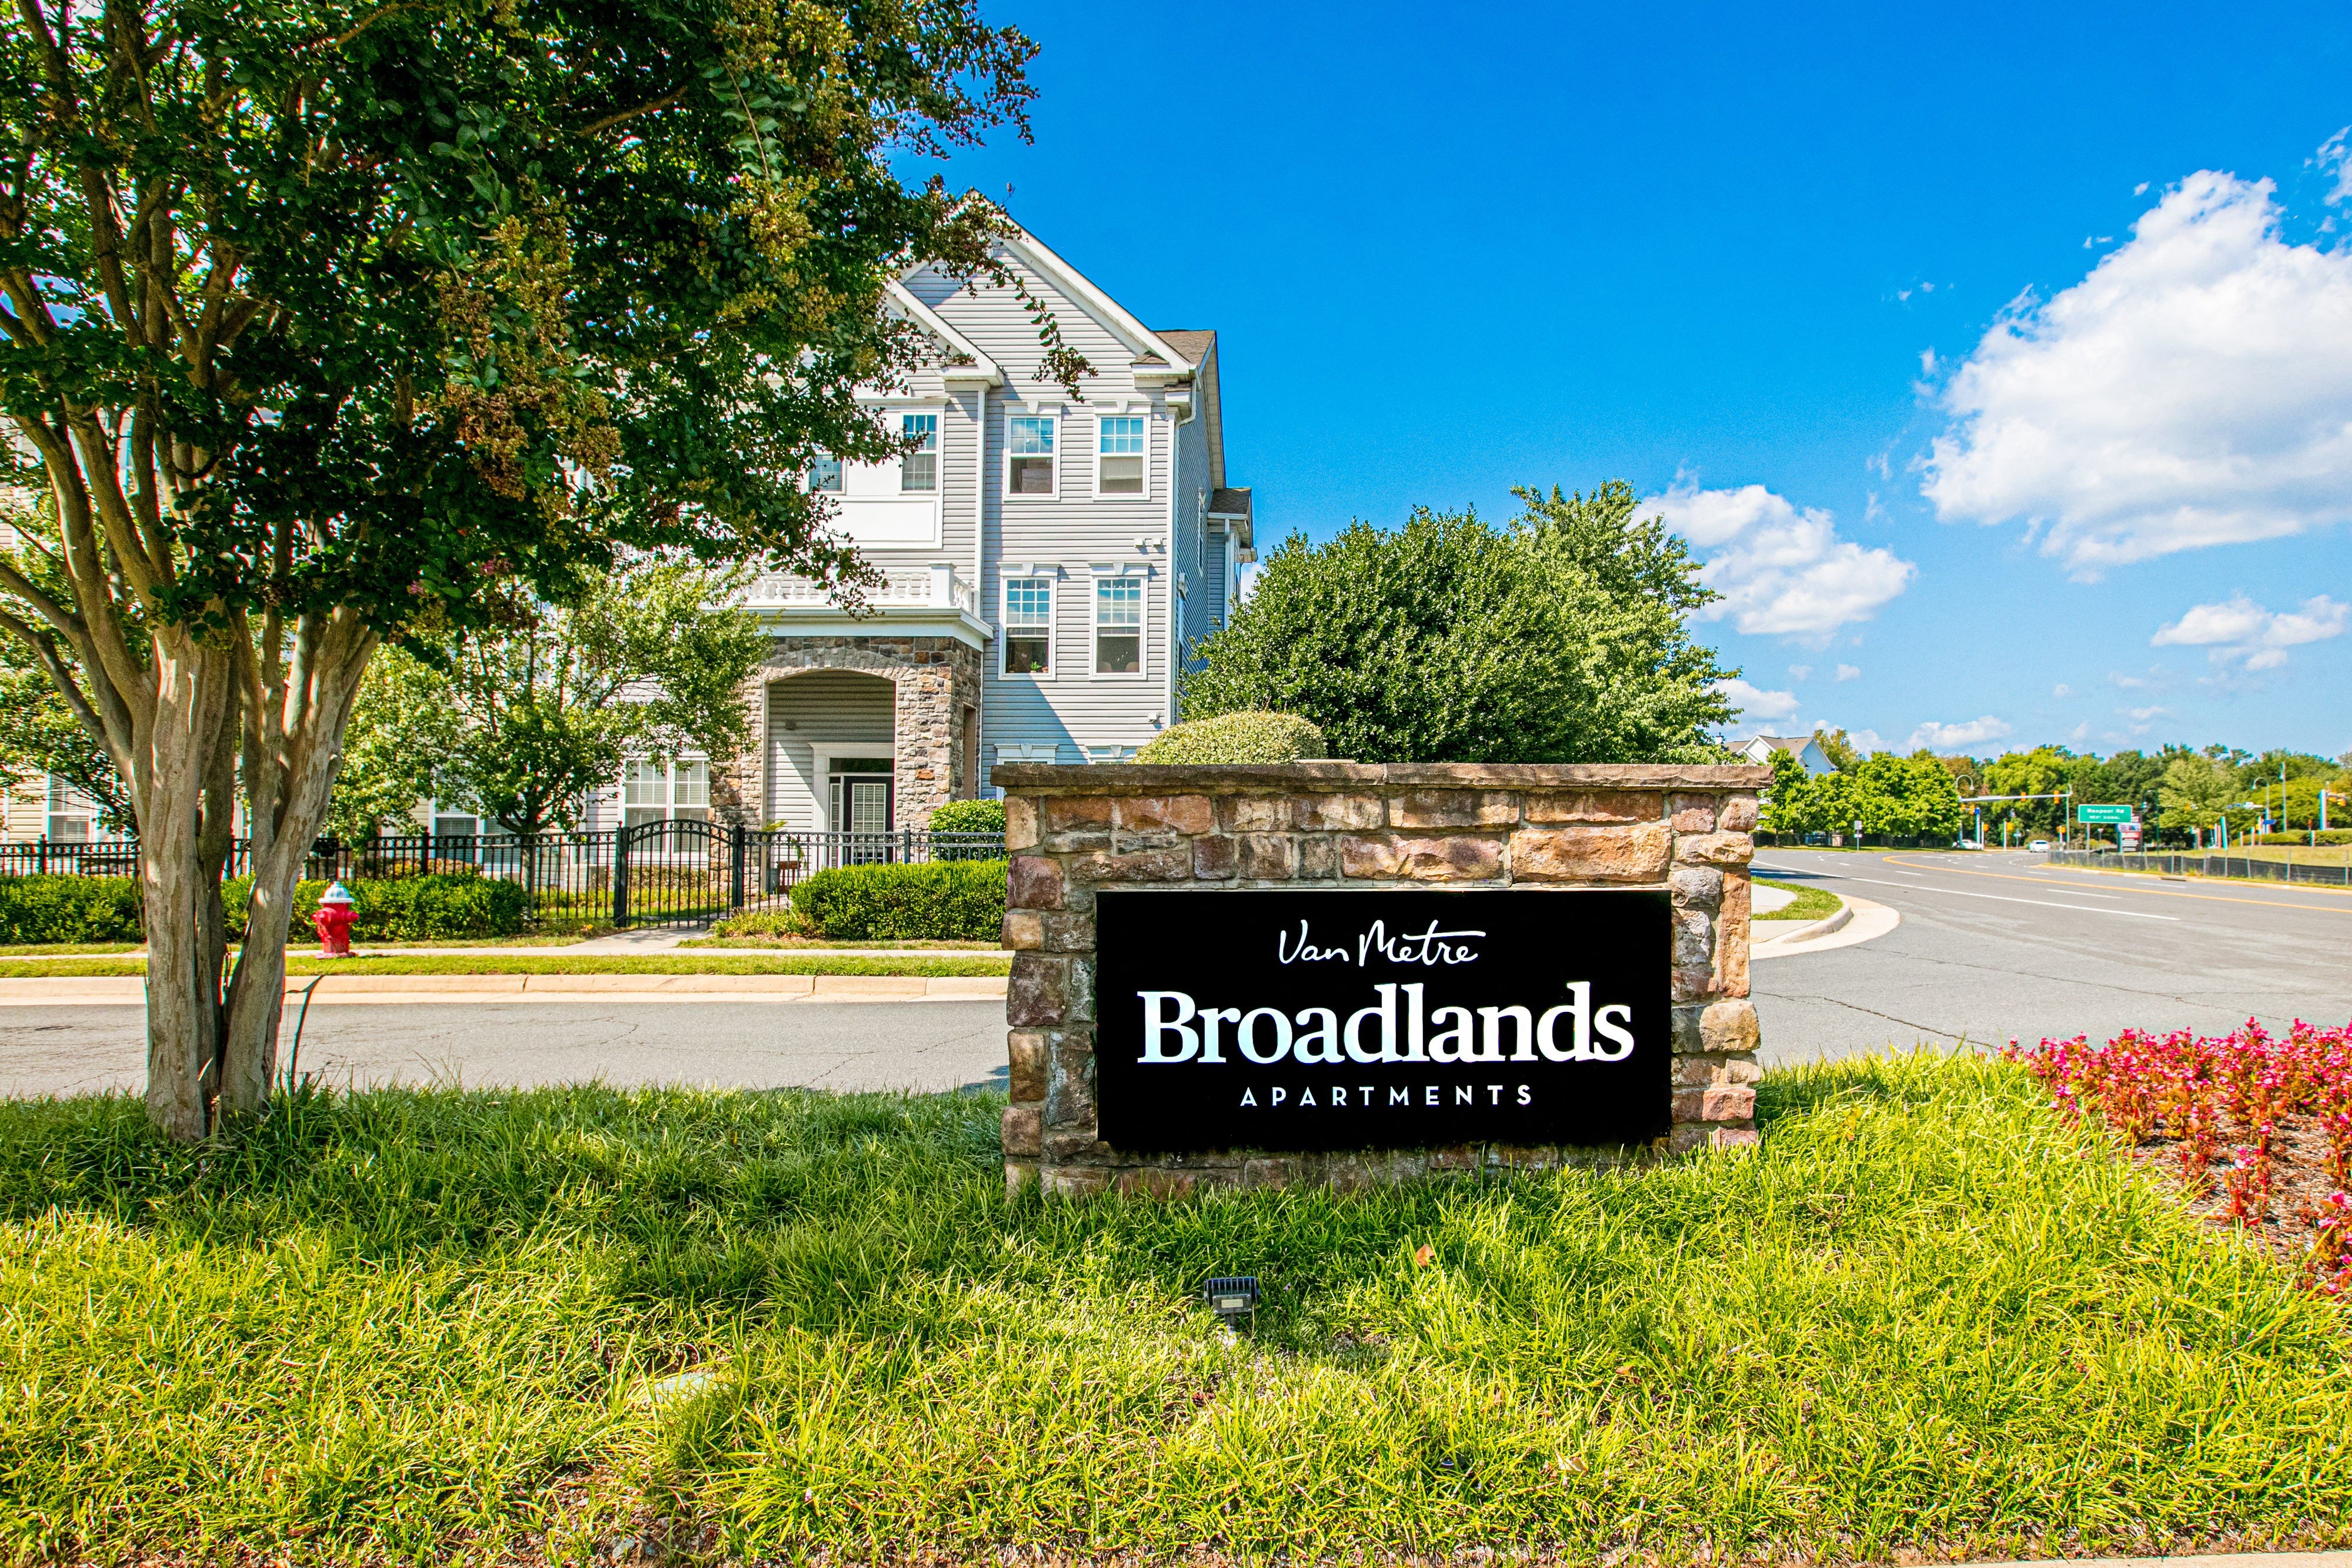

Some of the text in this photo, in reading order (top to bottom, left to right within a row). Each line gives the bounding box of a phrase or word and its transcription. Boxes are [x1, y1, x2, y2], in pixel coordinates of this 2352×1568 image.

[1278, 918, 1487, 968] Van Metre
[1137, 981, 1635, 1064] Broadlands
[1240, 1084, 1532, 1106] APARTMENTS
